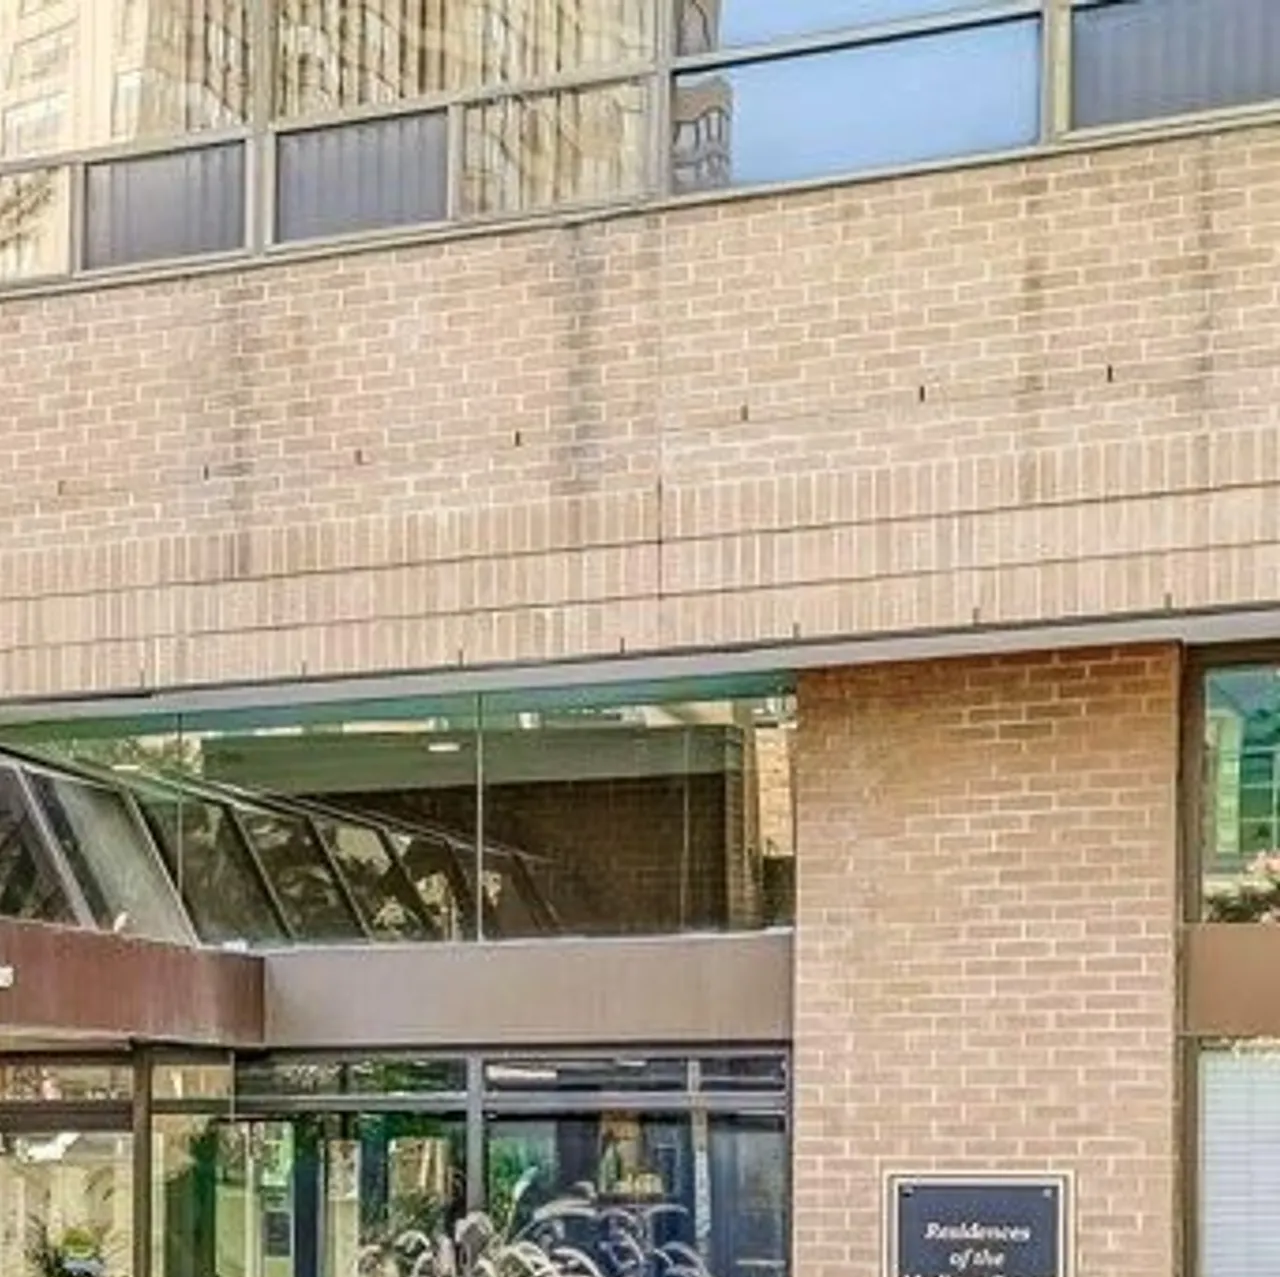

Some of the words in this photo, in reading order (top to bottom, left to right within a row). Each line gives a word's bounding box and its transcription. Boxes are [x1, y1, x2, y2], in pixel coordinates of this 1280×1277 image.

[924, 1222, 1032, 1242] Residences
[949, 1248, 974, 1270] of
[972, 1250, 1005, 1266] the
